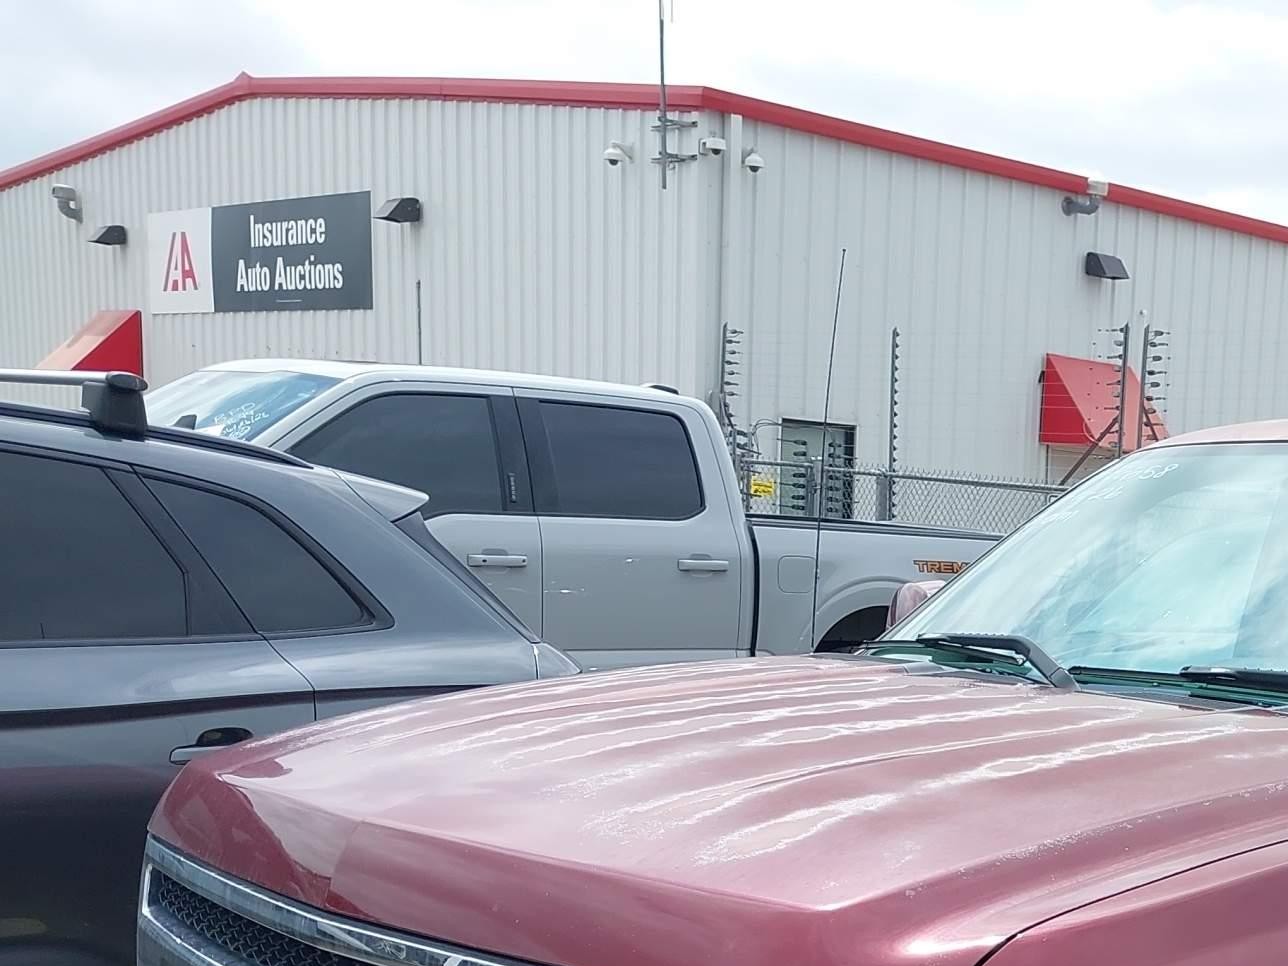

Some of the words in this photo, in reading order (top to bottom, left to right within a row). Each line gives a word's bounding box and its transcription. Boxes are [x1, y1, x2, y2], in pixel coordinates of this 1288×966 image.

[249, 214, 326, 249] Insurance
[235, 258, 271, 292] Auto
[274, 254, 344, 291] Auctions
